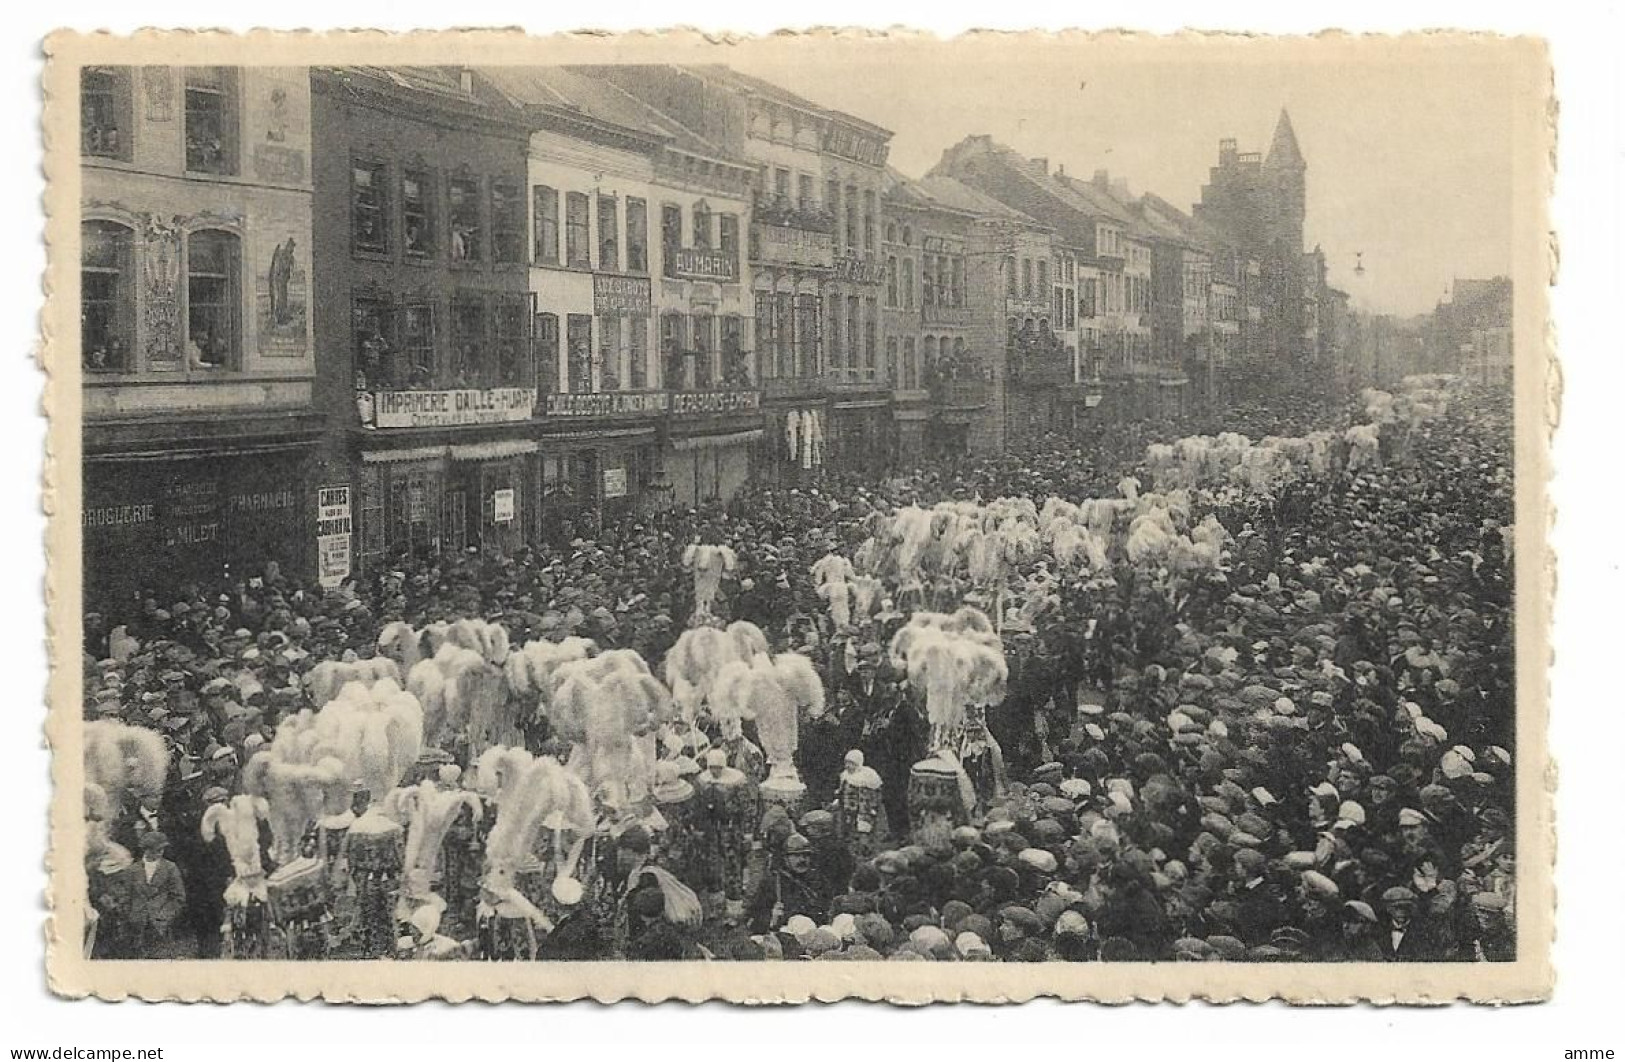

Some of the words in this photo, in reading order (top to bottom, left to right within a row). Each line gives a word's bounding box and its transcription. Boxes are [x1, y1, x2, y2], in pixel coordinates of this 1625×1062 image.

[676, 252, 693, 272] AU
[695, 253, 733, 276] MARIN
[381, 392, 449, 414] IMPRIMERIE
[229, 490, 295, 513] PHARMACIE
[320, 489, 347, 507] CARTES
